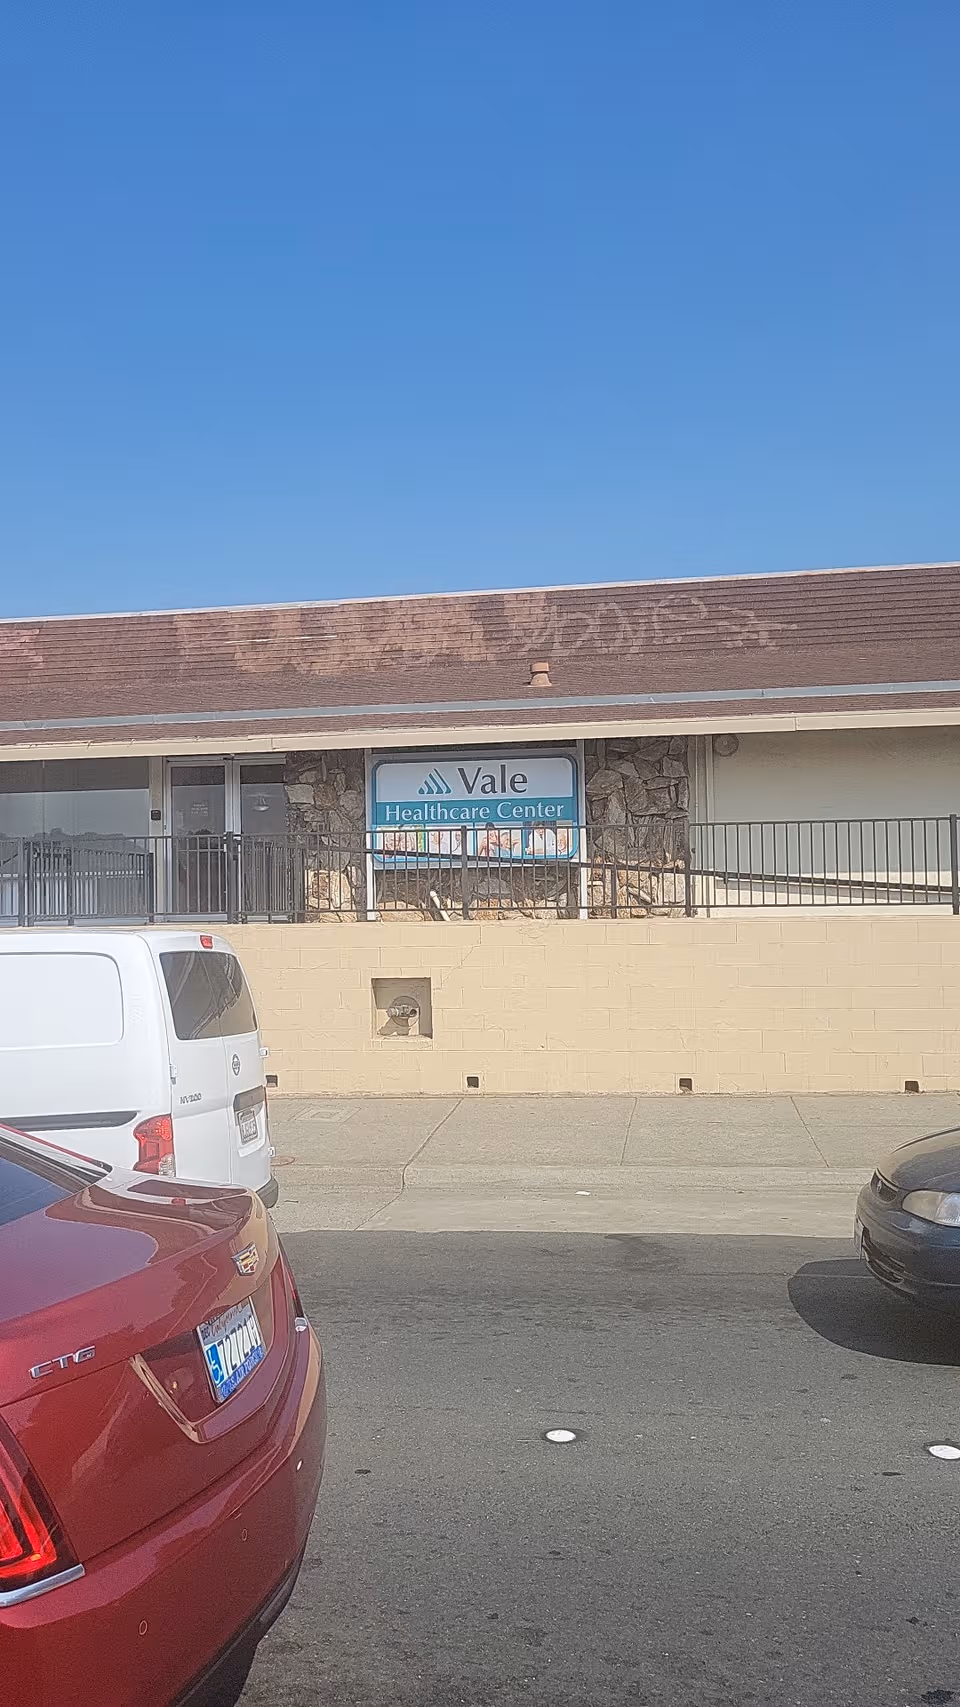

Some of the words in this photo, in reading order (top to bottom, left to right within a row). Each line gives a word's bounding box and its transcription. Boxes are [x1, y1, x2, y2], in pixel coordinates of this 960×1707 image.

[457, 764, 528, 795] Vale
[385, 802, 491, 822] Healthcare
[496, 801, 565, 820] Center
